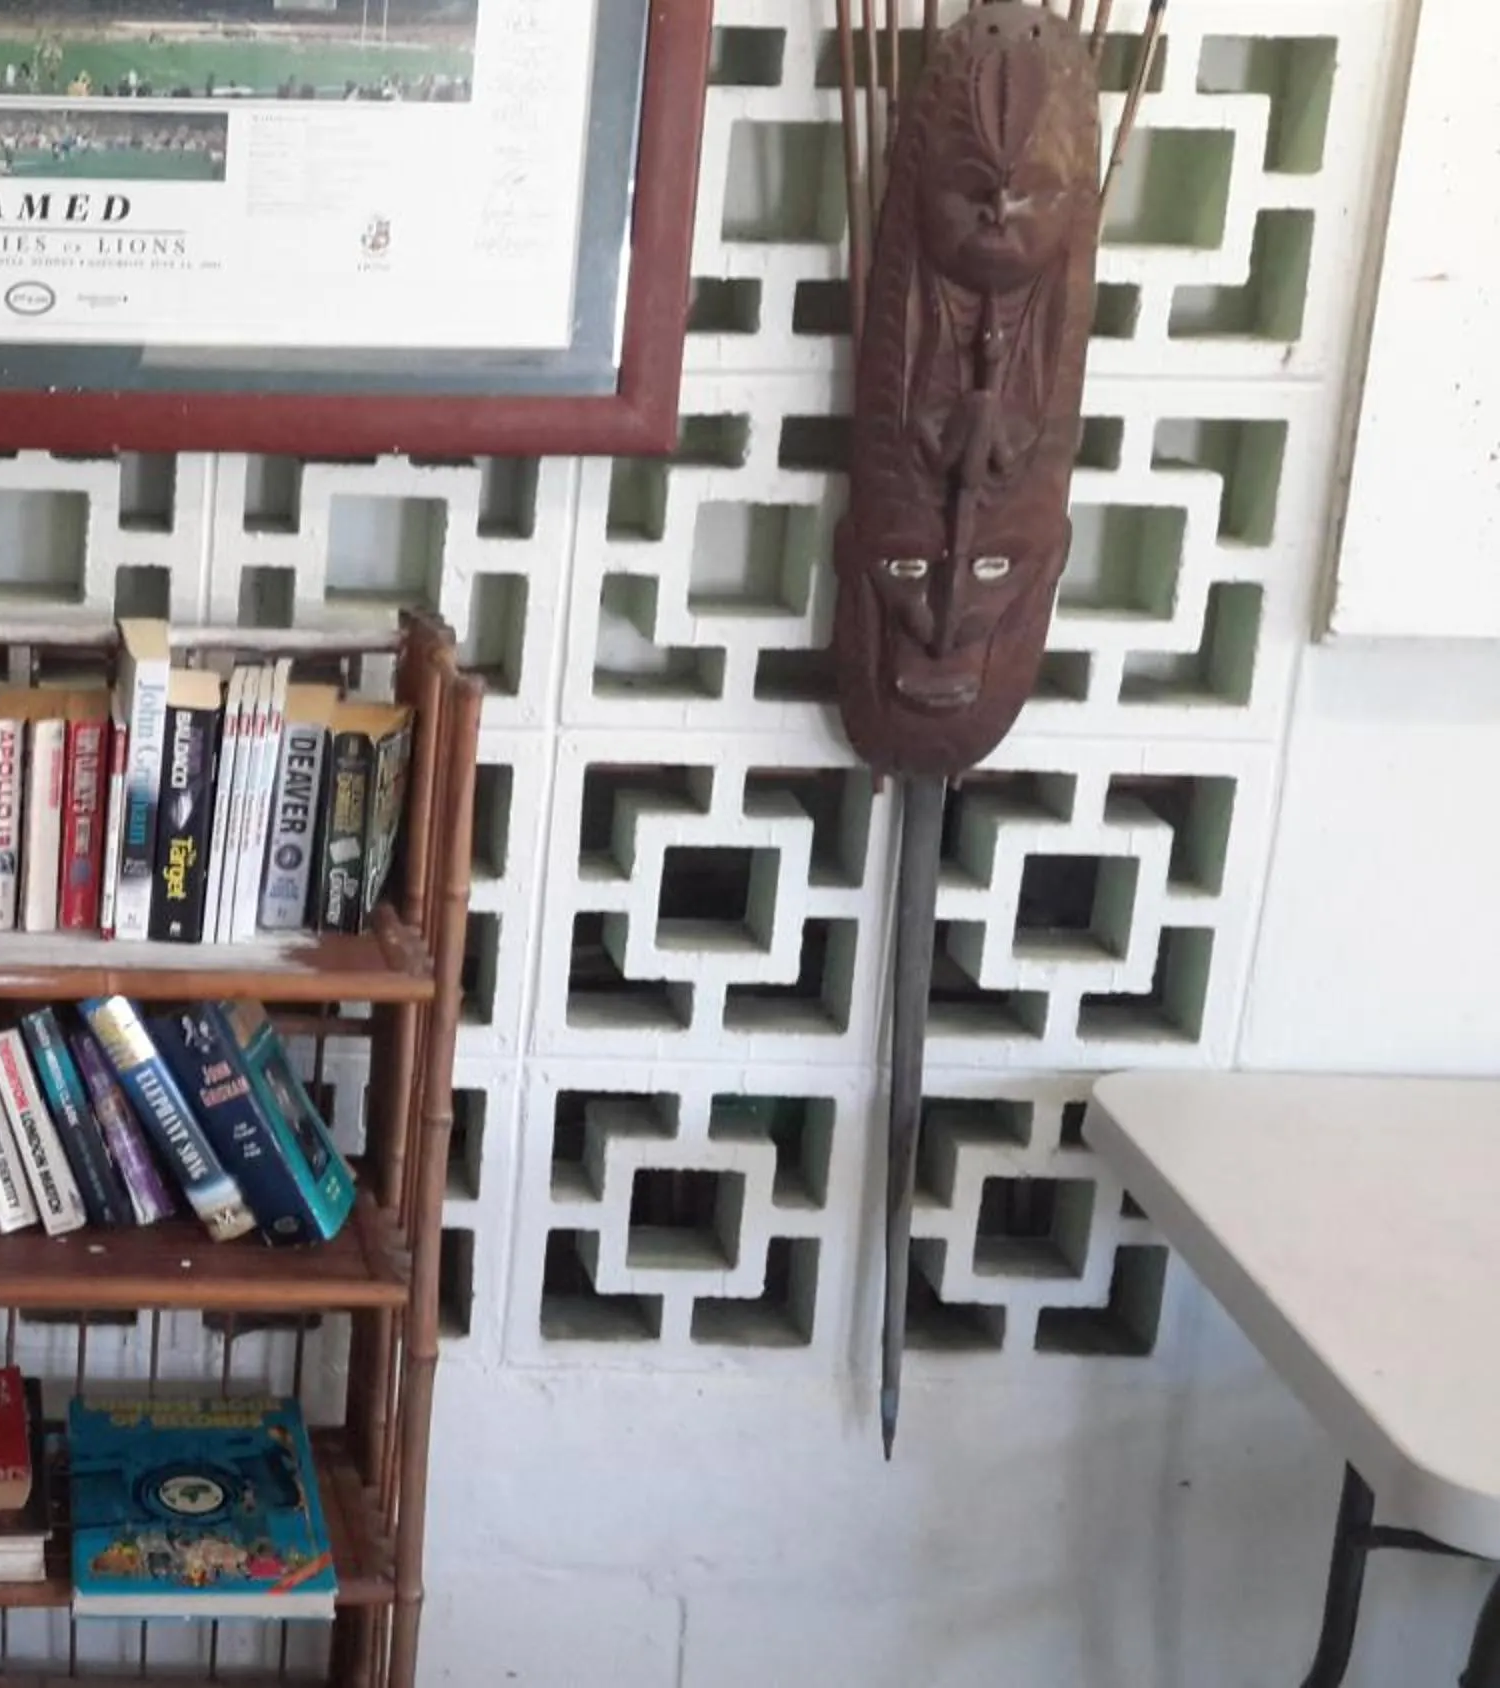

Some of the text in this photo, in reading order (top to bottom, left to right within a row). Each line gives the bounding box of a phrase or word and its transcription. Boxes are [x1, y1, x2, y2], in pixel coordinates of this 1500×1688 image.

[98, 236, 187, 255] LIONS
[137, 680, 166, 739] John
[280, 736, 317, 835] DEAVER
[163, 836, 194, 900] Target
[21, 1112, 47, 1167] LONDON
[134, 1068, 209, 1180] ELEPHANT SONG
